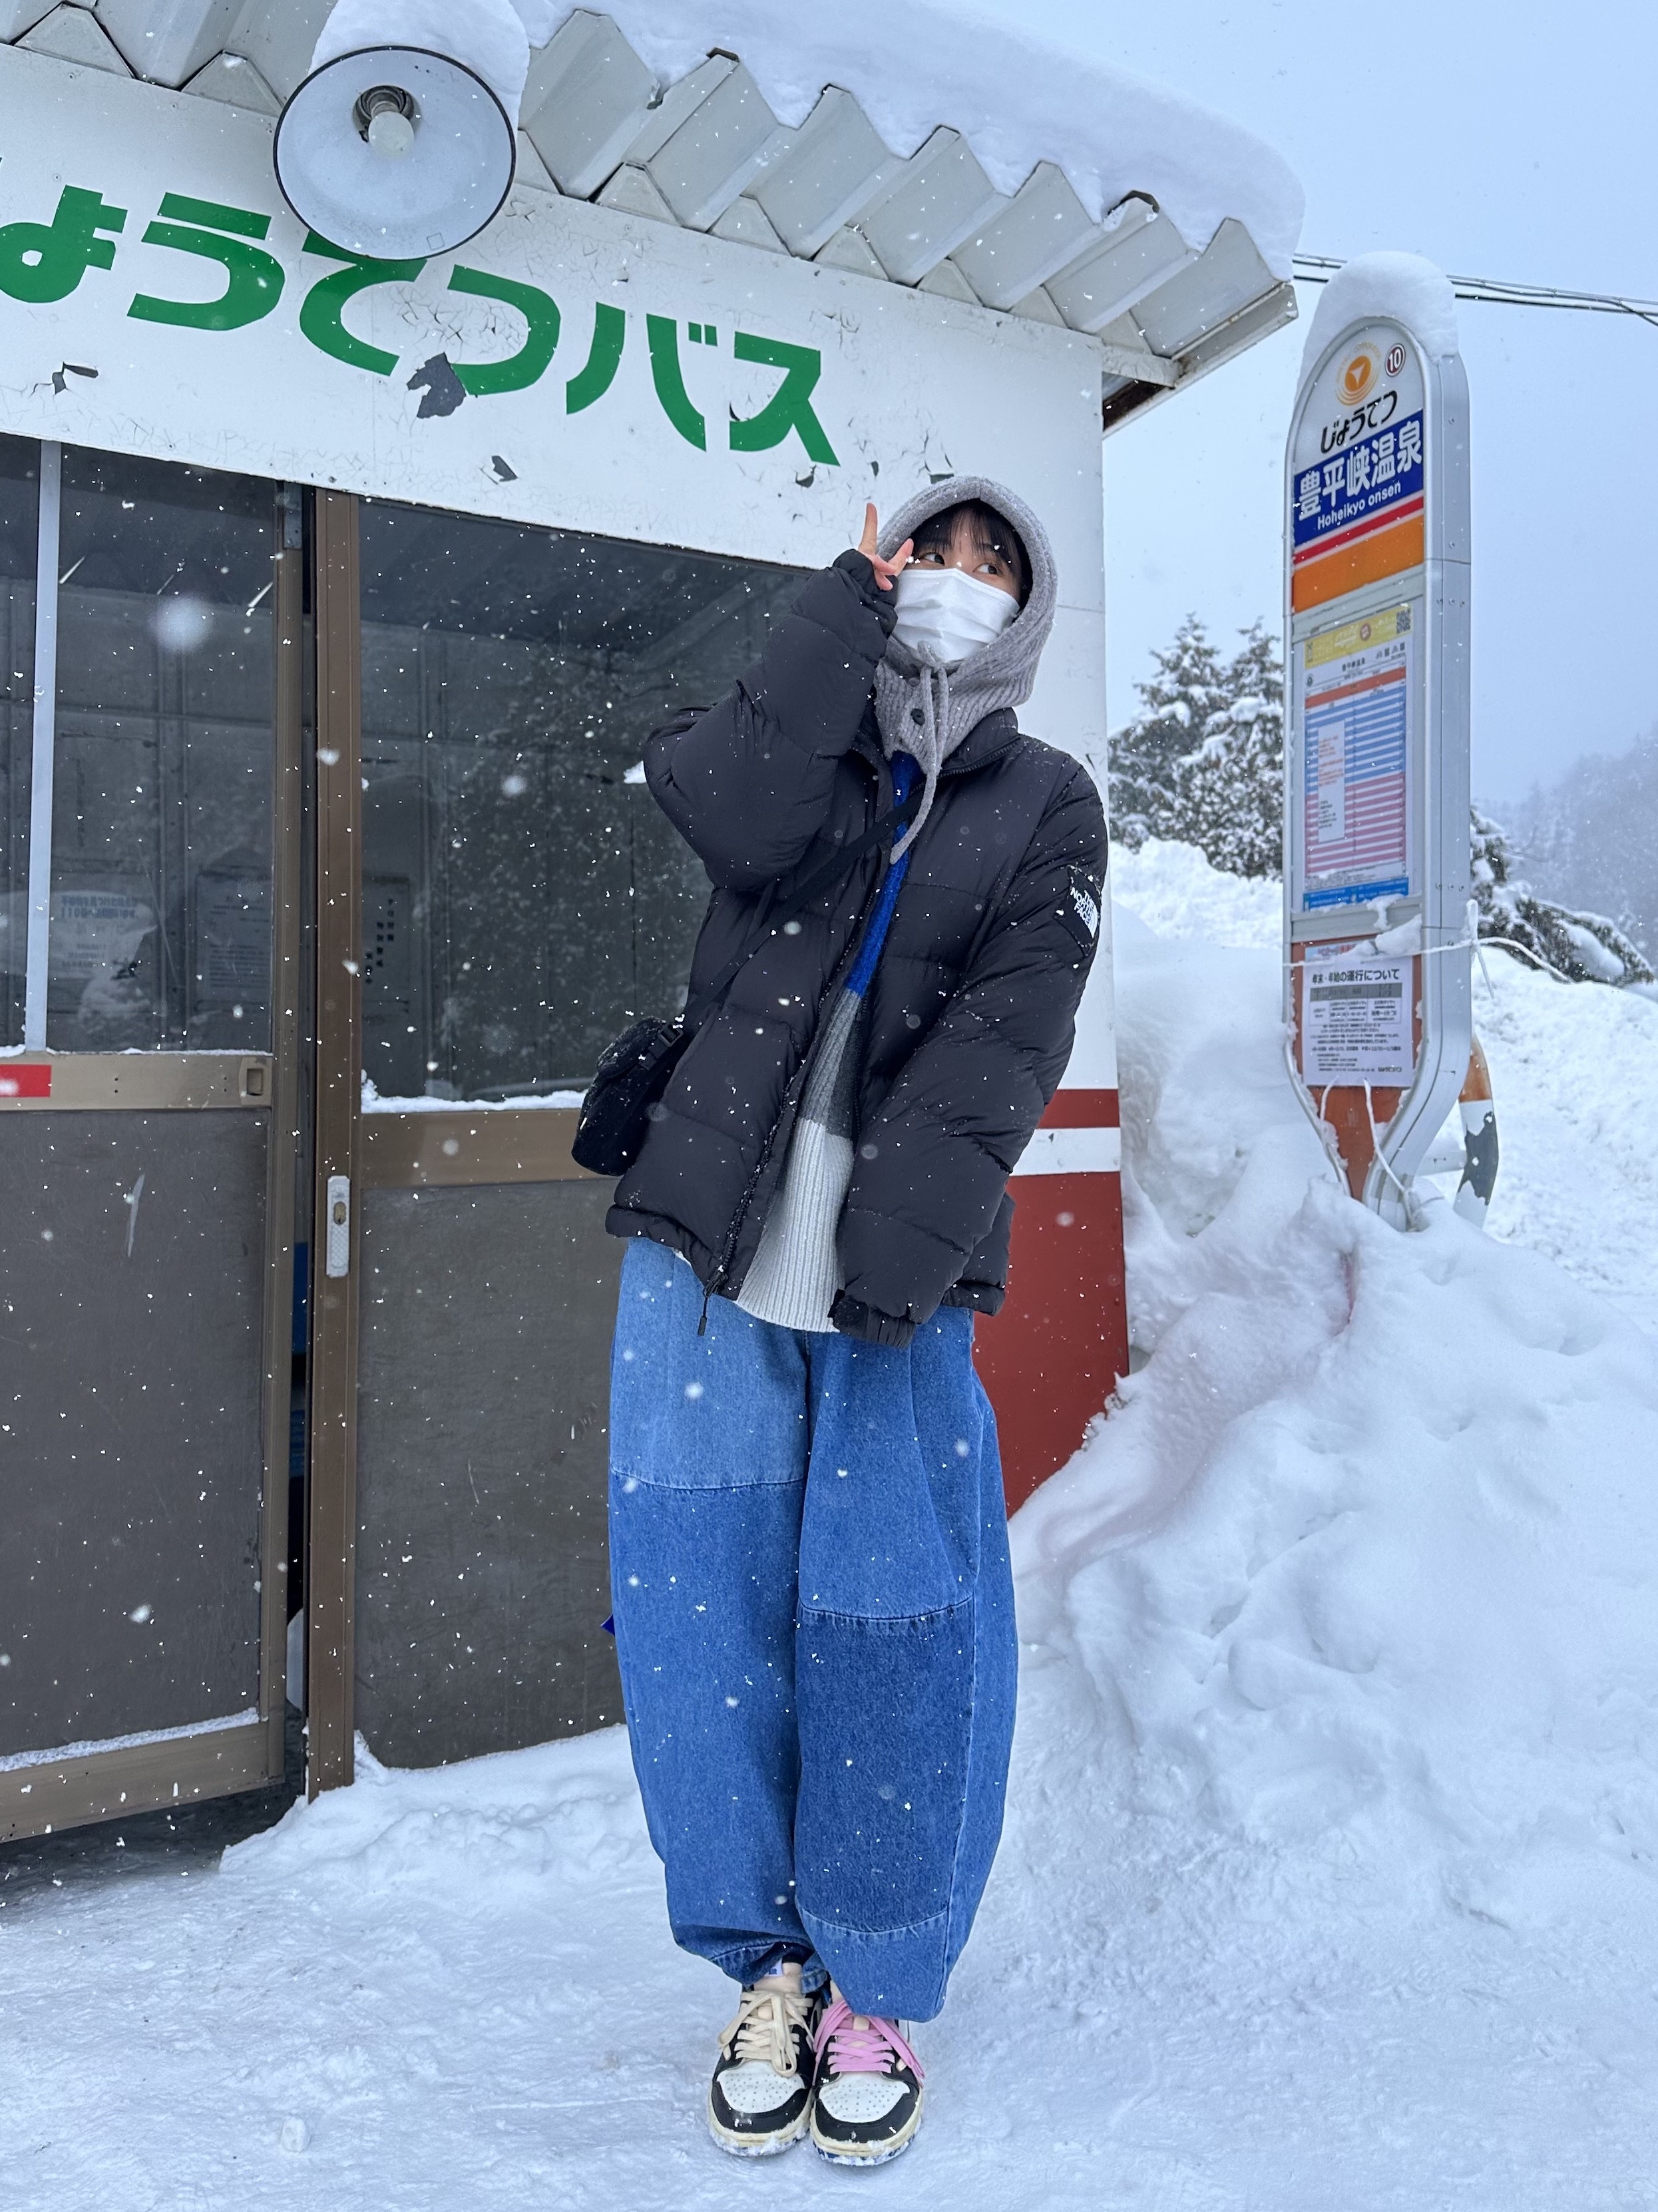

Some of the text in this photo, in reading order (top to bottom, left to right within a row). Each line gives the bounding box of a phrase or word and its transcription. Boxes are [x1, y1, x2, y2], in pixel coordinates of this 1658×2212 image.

[0, 184, 840, 467] ょうてつバス
[1387, 347, 1402, 373] 10
[1320, 390, 1398, 454] じょうてつ
[1299, 421, 1422, 522] 豊平峡温泉
[1317, 482, 1402, 530] Hoheikyo onsen
[1070, 887, 1093, 916] NORTH
[1074, 902, 1092, 926] FACE
